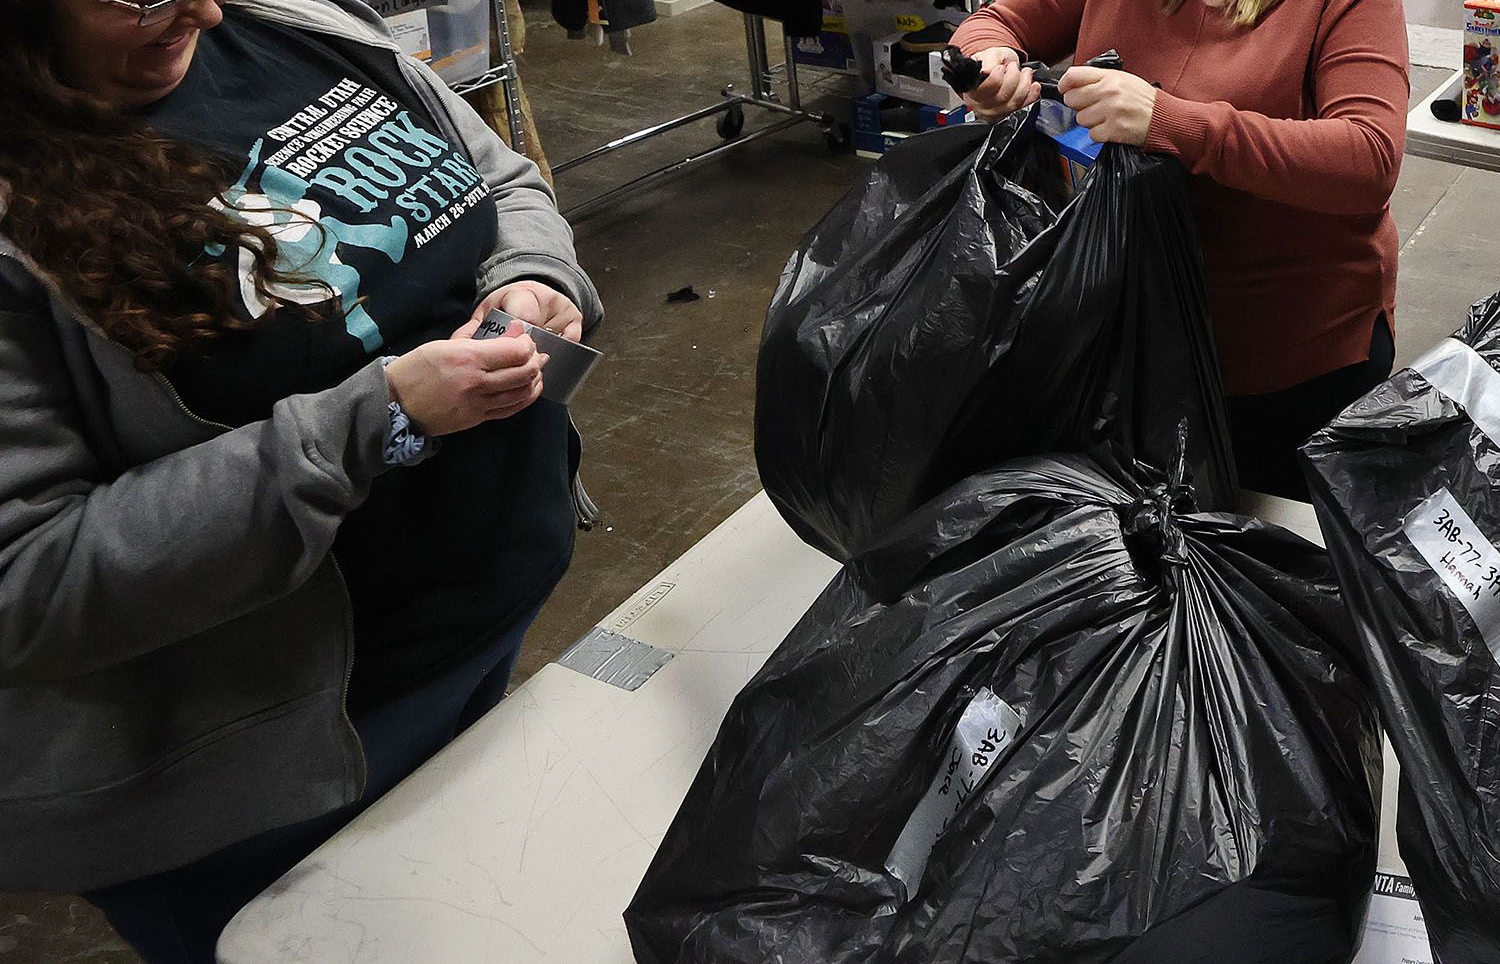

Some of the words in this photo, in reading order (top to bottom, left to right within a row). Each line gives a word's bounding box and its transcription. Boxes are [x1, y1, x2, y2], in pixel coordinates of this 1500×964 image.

[896, 16, 918, 27] Kids
[264, 137, 305, 168] SCIENCE
[352, 87, 377, 111] FAIR
[266, 104, 328, 142] CENTRAL
[318, 77, 361, 109] UTAH
[286, 133, 351, 179] ROCKET
[341, 95, 399, 140] SCIENCE
[309, 110, 449, 214] ROCK
[414, 214, 451, 248] MARCH
[1440, 550, 1482, 601] Hannah
